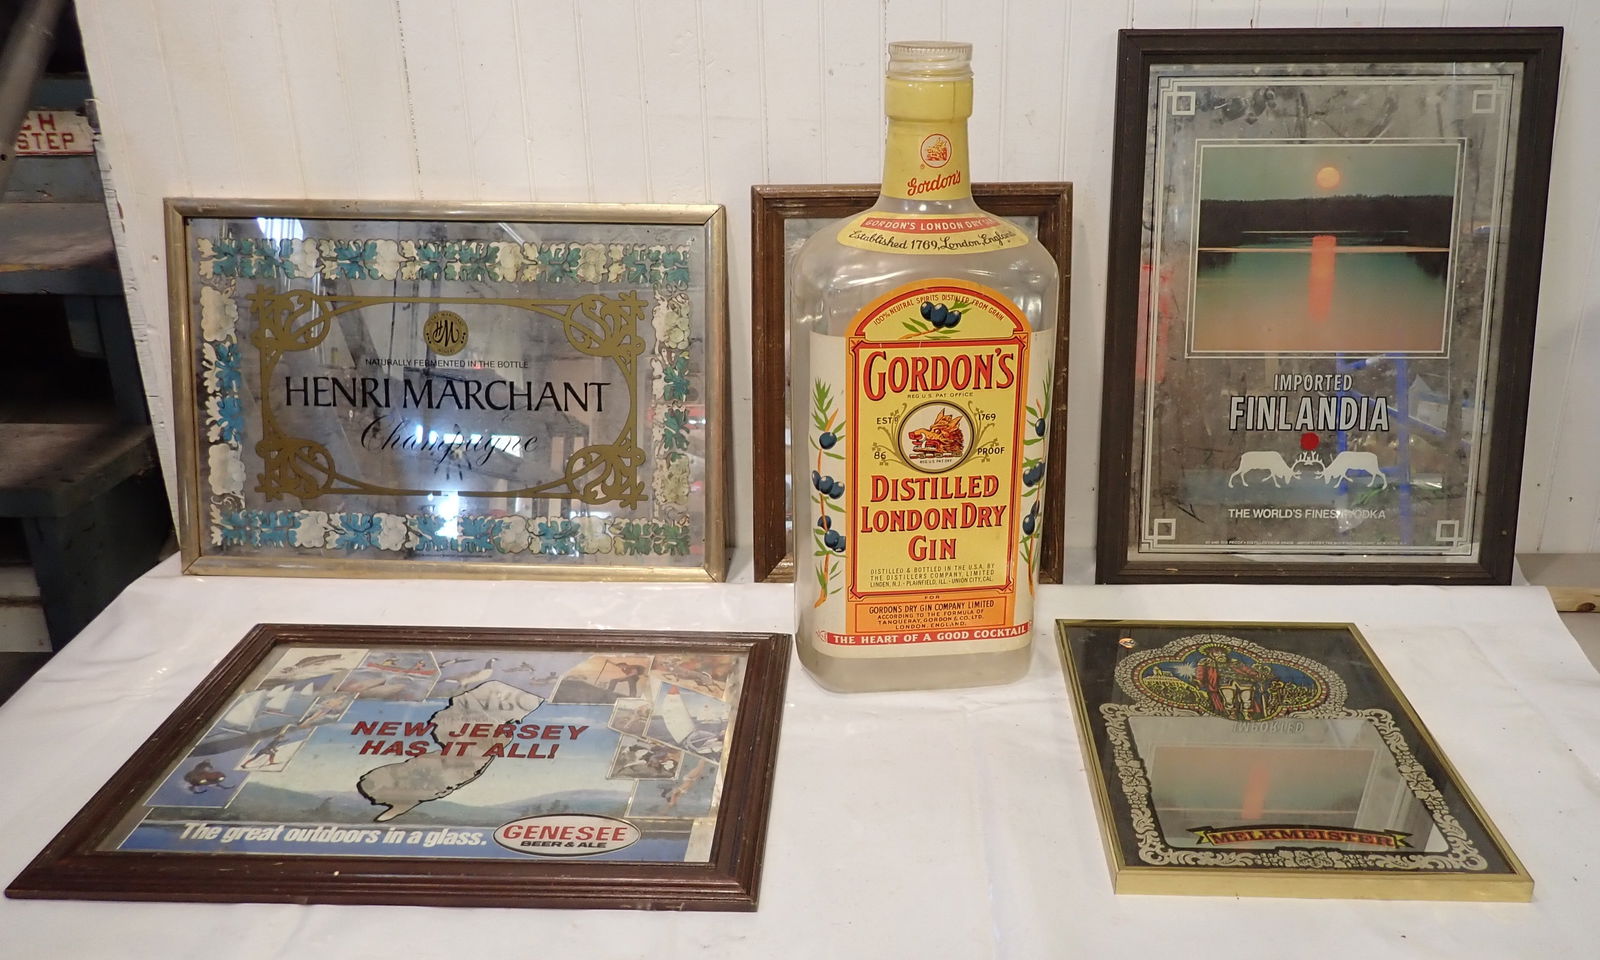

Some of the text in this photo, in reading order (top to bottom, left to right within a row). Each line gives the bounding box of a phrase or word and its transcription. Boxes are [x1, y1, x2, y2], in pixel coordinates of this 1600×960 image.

[16, 132, 75, 149] STEP
[907, 169, 961, 196] Gordon's
[865, 218, 916, 231] GORDON'S
[920, 221, 964, 231] LONDON
[965, 219, 981, 228] DRY
[848, 229, 908, 250] Established
[874, 310, 890, 325] 100%
[890, 301, 914, 315] NEUTRAL
[916, 294, 939, 304] SPIRITS
[971, 299, 989, 311] FROM
[988, 307, 1005, 321] GRAIN
[365, 359, 529, 369] NATURALLY FERMENTED IN THE BOTTLE
[863, 348, 1014, 401] GORDON'S
[1273, 374, 1353, 391] IMPORTED
[285, 376, 612, 412] HENRI MARCHANT
[978, 413, 997, 421] 1769
[1229, 395, 1390, 431] FINLANDIA
[361, 415, 538, 466] Champagne
[873, 451, 887, 460] 86
[977, 447, 1005, 455] PROOF
[870, 474, 1000, 502] DISTILLED
[860, 502, 1008, 533] LONDON DRY
[1228, 508, 1250, 519] THE
[1252, 508, 1302, 519] WORLD'S
[908, 535, 957, 561] GIN
[913, 565, 942, 573] BOTTLED
[966, 569, 995, 577] LIMITED
[905, 604, 918, 612] DRY
[920, 603, 932, 612] GIN
[934, 601, 965, 611] COMPANY
[968, 600, 995, 609] LIMITED
[833, 625, 1026, 644] THE HEART OF A GOOD COCKTAIL
[351, 720, 589, 740] NEW JERSEY
[358, 740, 561, 760] HAS IT ALL!
[179, 822, 488, 848] The great outdoors in a glass.
[503, 824, 628, 842] GENESEE
[1212, 829, 1394, 846] MELKMEISTER
[520, 840, 607, 849] BEER & ALE
